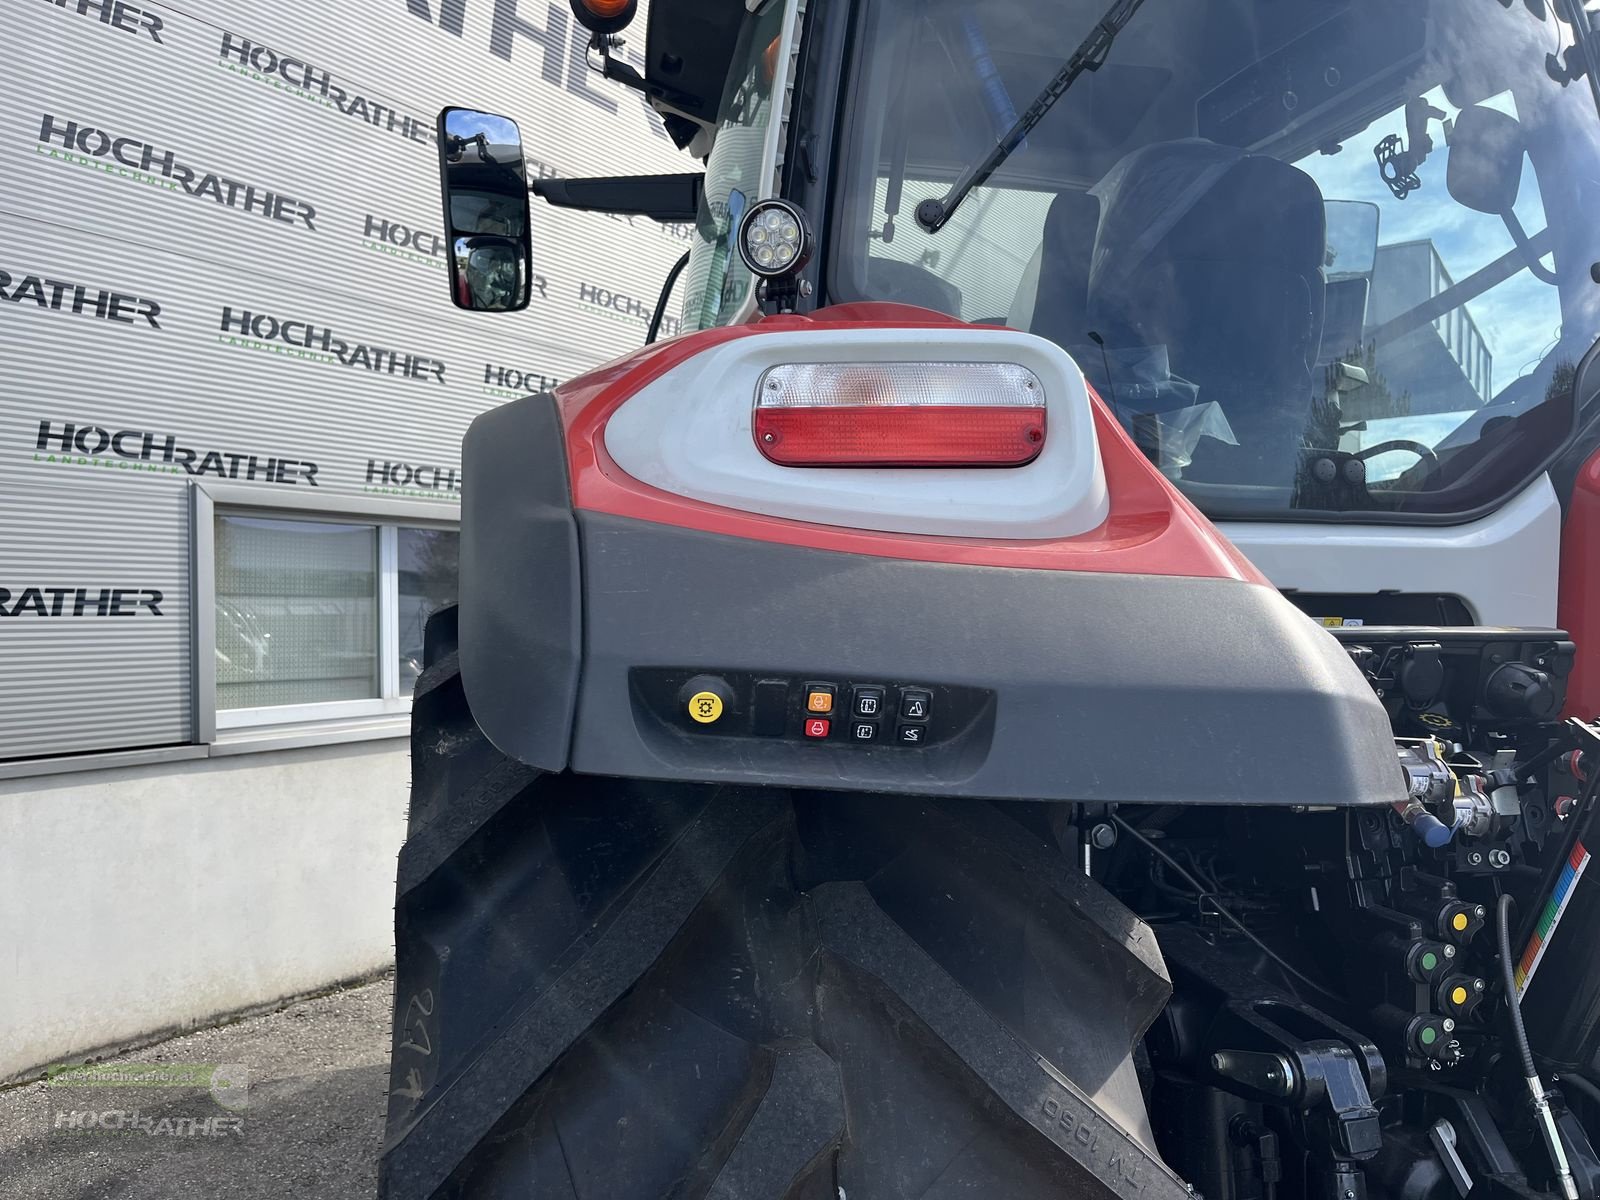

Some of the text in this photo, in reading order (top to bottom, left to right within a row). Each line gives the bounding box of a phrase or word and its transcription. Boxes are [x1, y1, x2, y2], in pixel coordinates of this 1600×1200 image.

[220, 31, 438, 146] HOCHRATHE
[36, 144, 179, 192] LANDTECHNIK
[39, 113, 317, 232] HOCHRATHER
[220, 306, 446, 384] HOCHRATHER
[33, 454, 182, 475] LANDTECHNIK
[36, 420, 319, 487] HOCHRATHER
